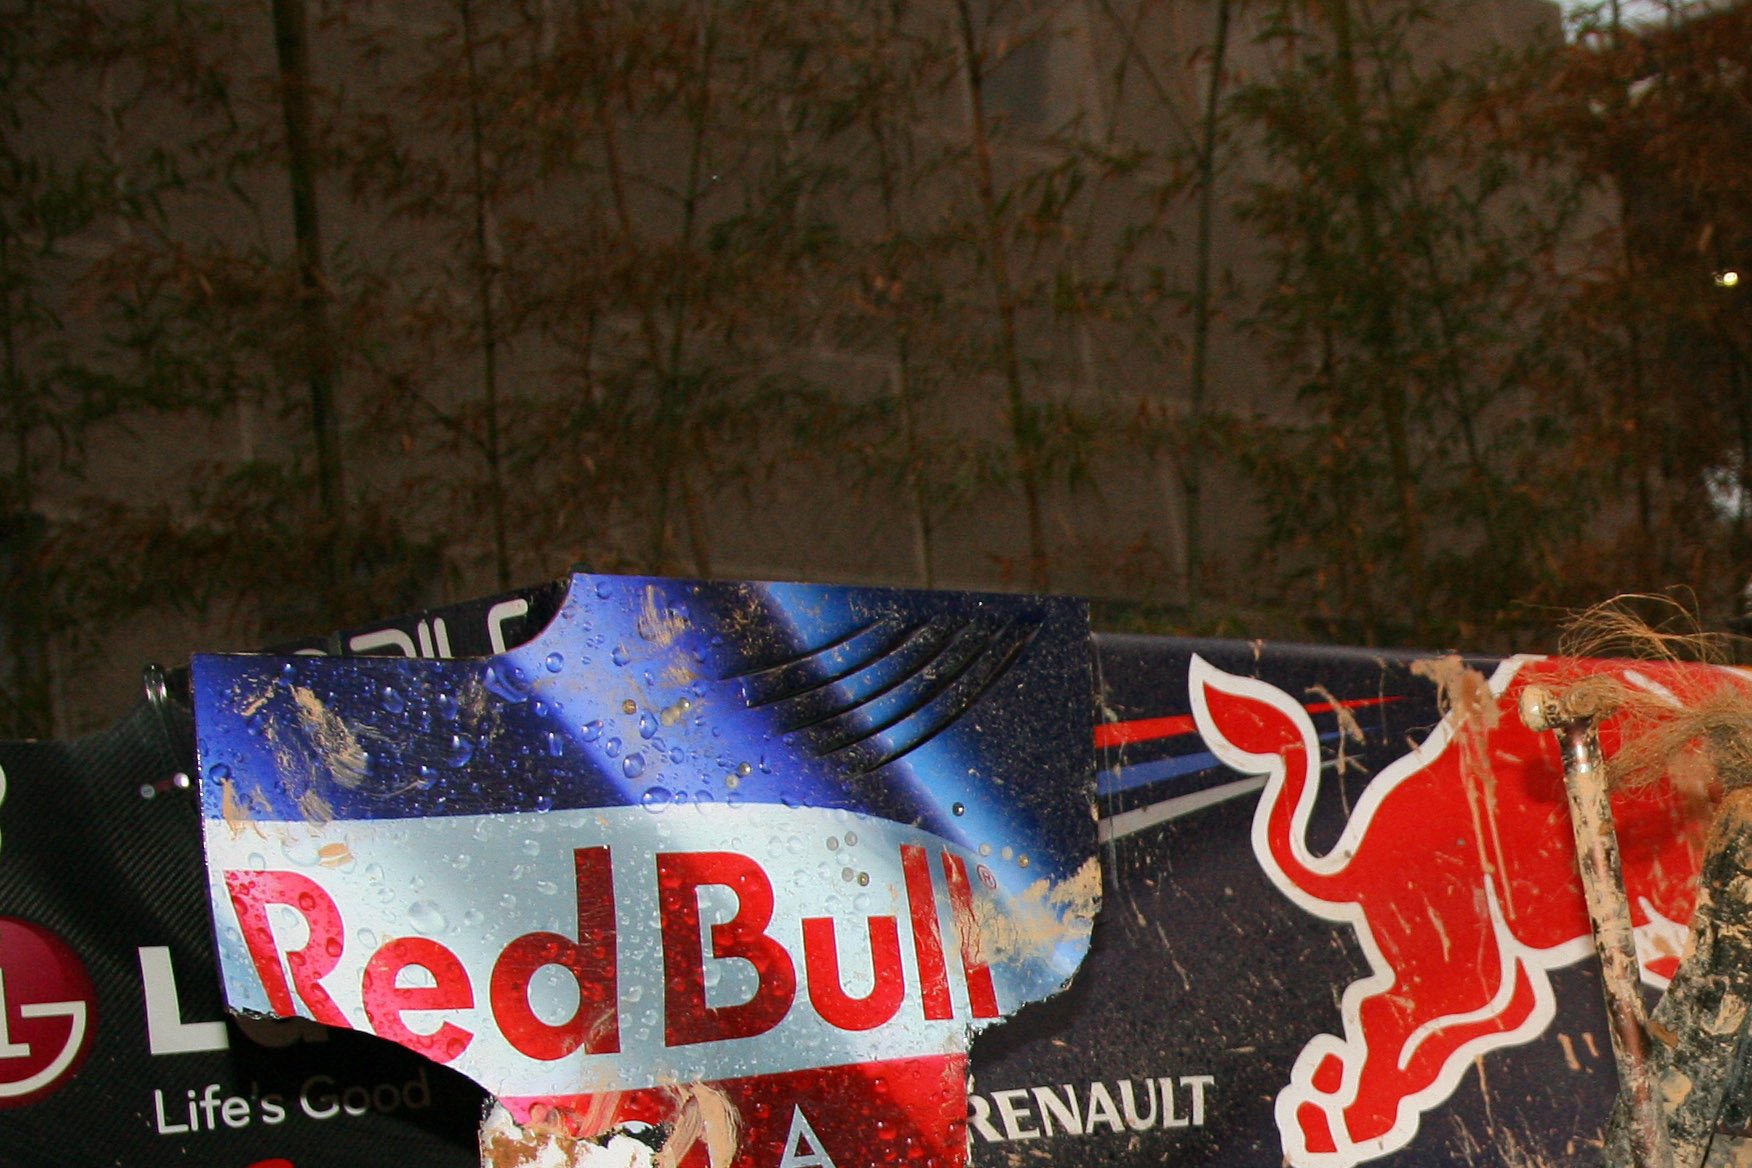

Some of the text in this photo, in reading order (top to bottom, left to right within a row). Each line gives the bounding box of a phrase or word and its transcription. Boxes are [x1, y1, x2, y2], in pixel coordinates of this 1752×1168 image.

[224, 844, 620, 1064] Red
[154, 1068, 431, 1135] Life's Good
[967, 1076, 1215, 1143] RENAULT
